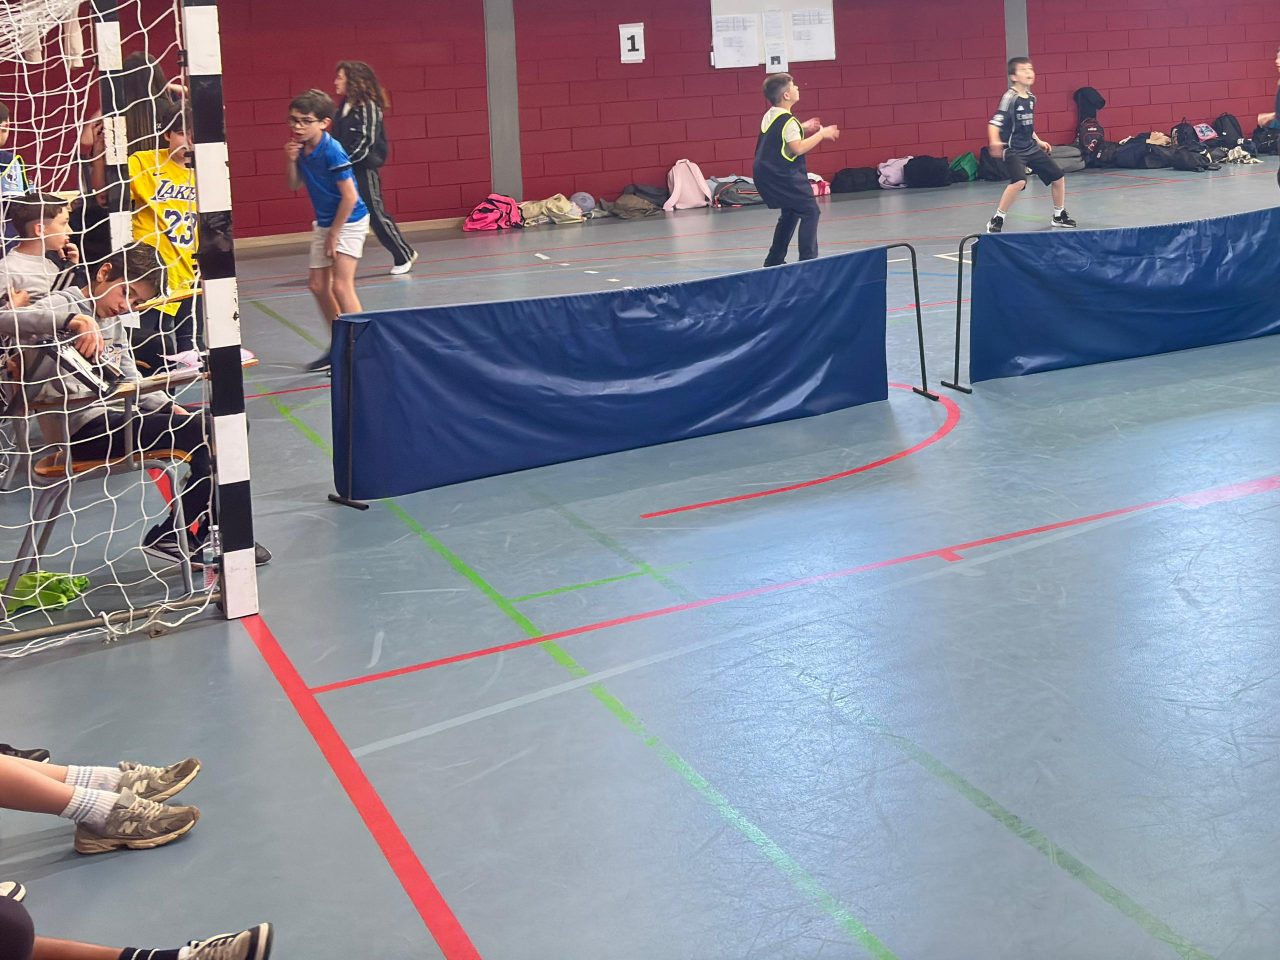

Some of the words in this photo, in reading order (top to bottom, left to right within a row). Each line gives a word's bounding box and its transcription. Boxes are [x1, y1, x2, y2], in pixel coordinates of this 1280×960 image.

[626, 35, 640, 52] 1
[150, 180, 197, 202] LAKE
[164, 209, 197, 245] 23
